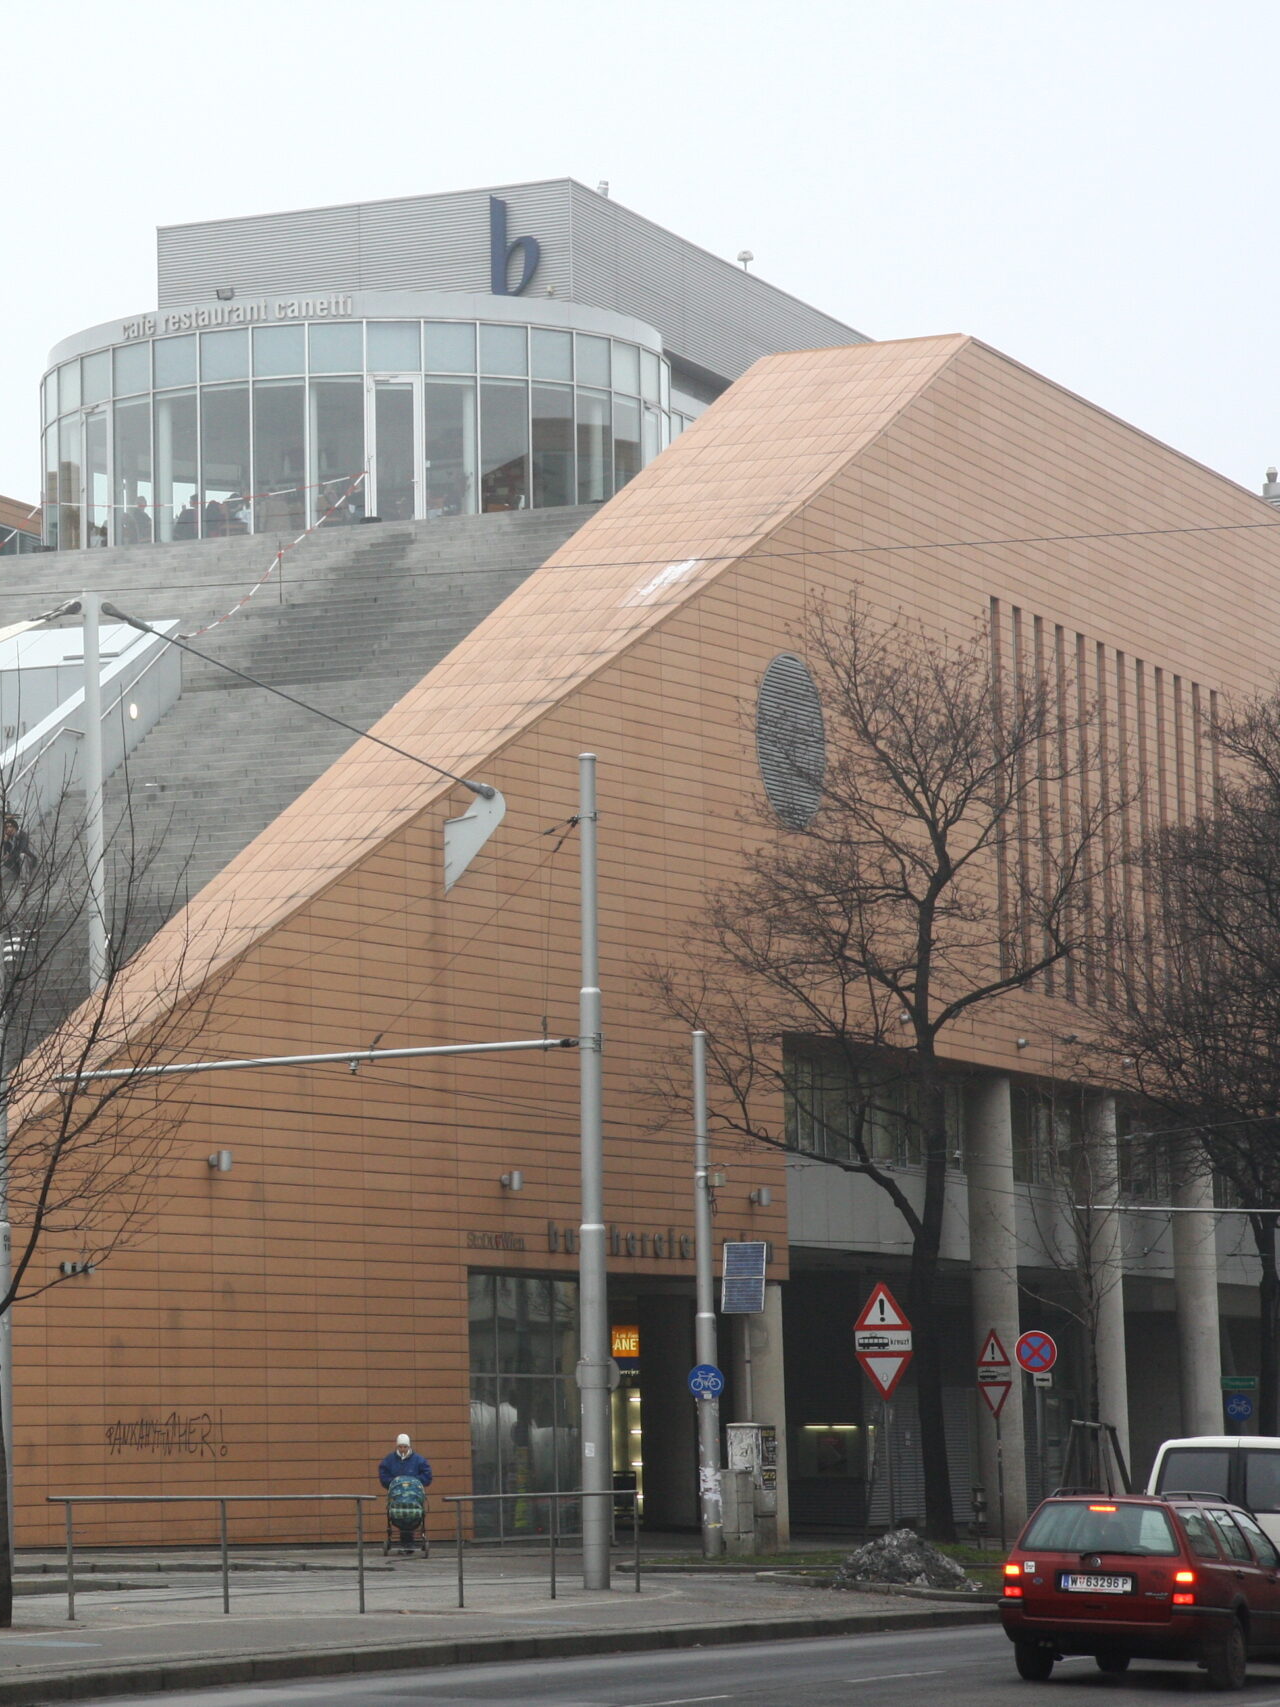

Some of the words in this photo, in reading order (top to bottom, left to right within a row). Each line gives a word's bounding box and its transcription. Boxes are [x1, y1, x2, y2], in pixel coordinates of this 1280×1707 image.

[163, 298, 267, 333] restaurant
[274, 295, 353, 319] canetti
[1071, 1576, 1078, 1586] W
[1086, 1577, 1119, 1588] 63296
[1121, 1578, 1129, 1588] P
